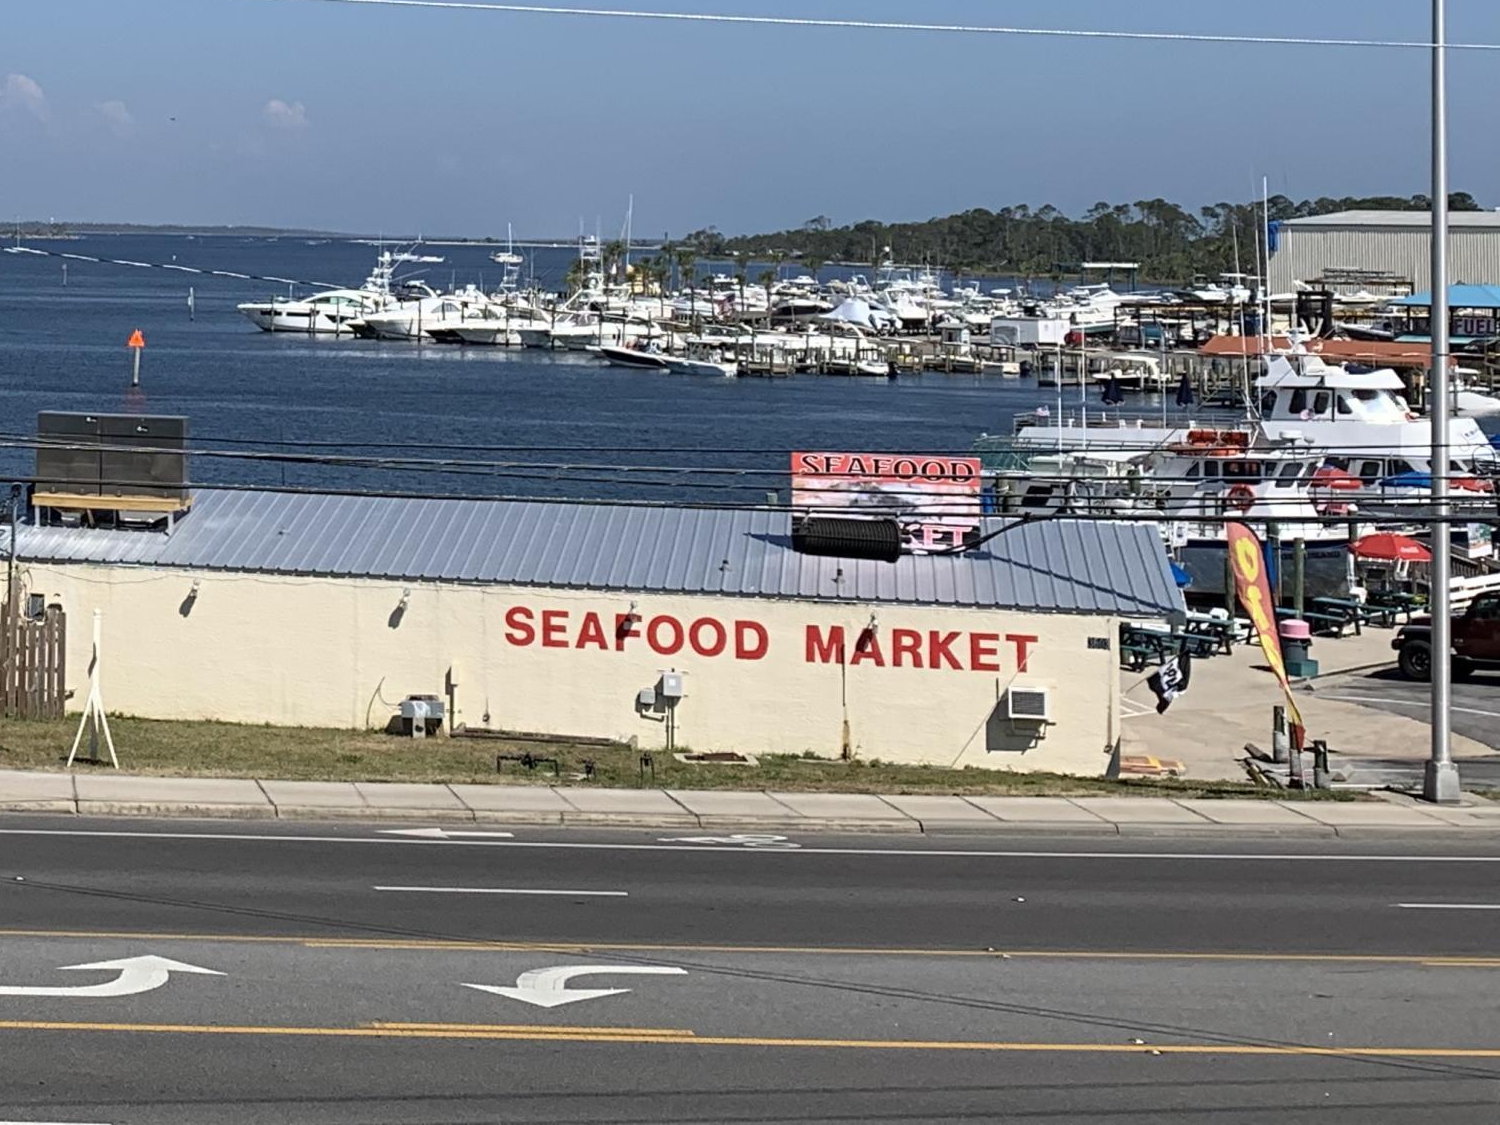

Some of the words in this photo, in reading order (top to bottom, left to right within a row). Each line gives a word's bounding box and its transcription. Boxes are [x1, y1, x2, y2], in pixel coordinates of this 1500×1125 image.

[1455, 318, 1494, 334] FUEL
[799, 455, 975, 483] SEAFOOD
[504, 606, 769, 661] SEAFOOD
[805, 624, 1038, 674] MARKET
